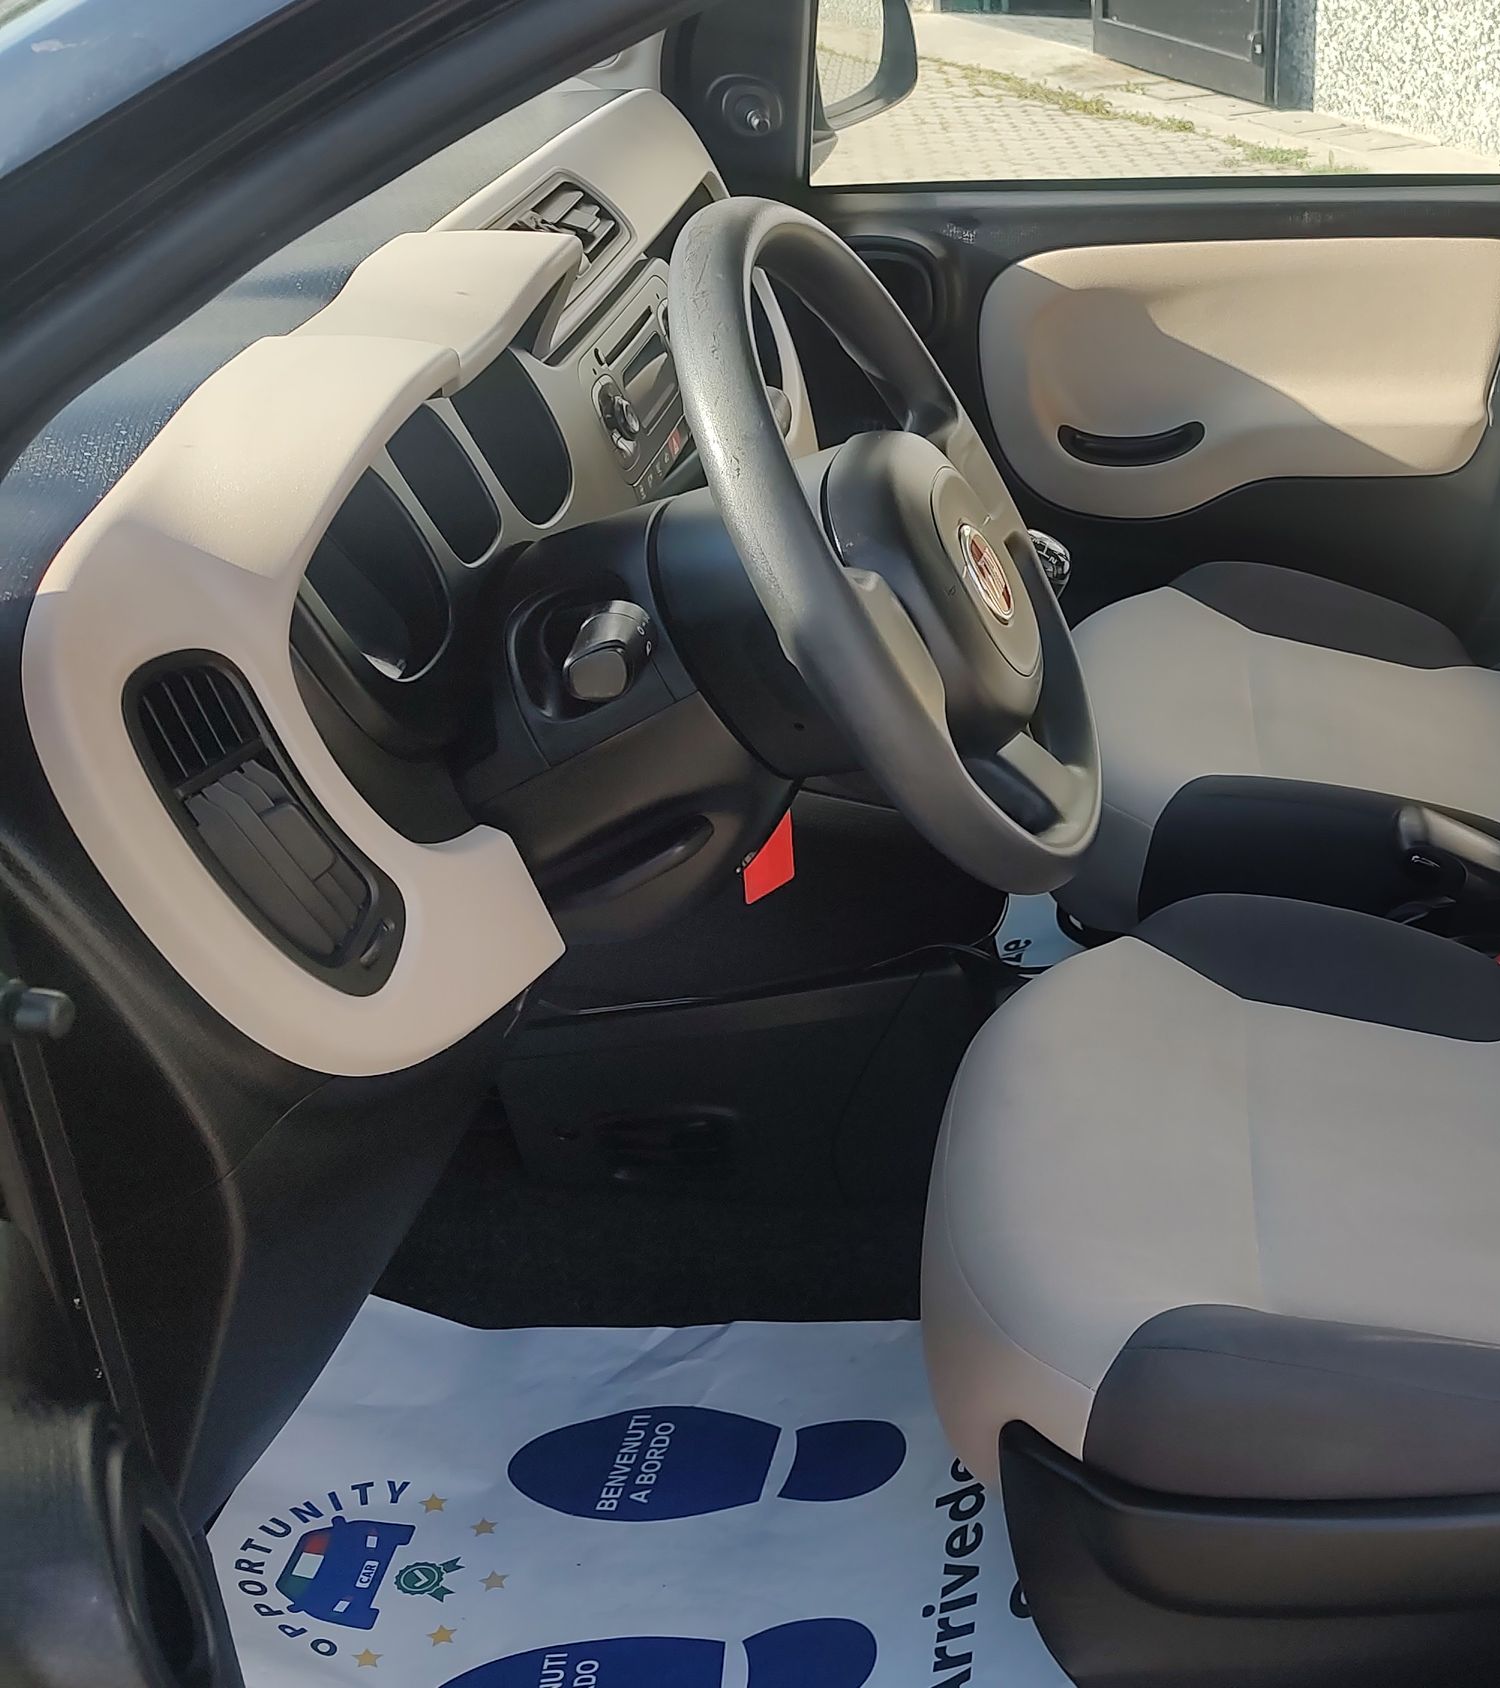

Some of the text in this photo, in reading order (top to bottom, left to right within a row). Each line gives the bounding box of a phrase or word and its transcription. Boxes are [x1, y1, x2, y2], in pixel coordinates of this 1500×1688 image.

[596, 1414, 652, 1512] BENVENUTI
[629, 1422, 676, 1504] A BORDO
[234, 1480, 411, 1657] OPPORTUNITY
[359, 1563, 377, 1585] CAR
